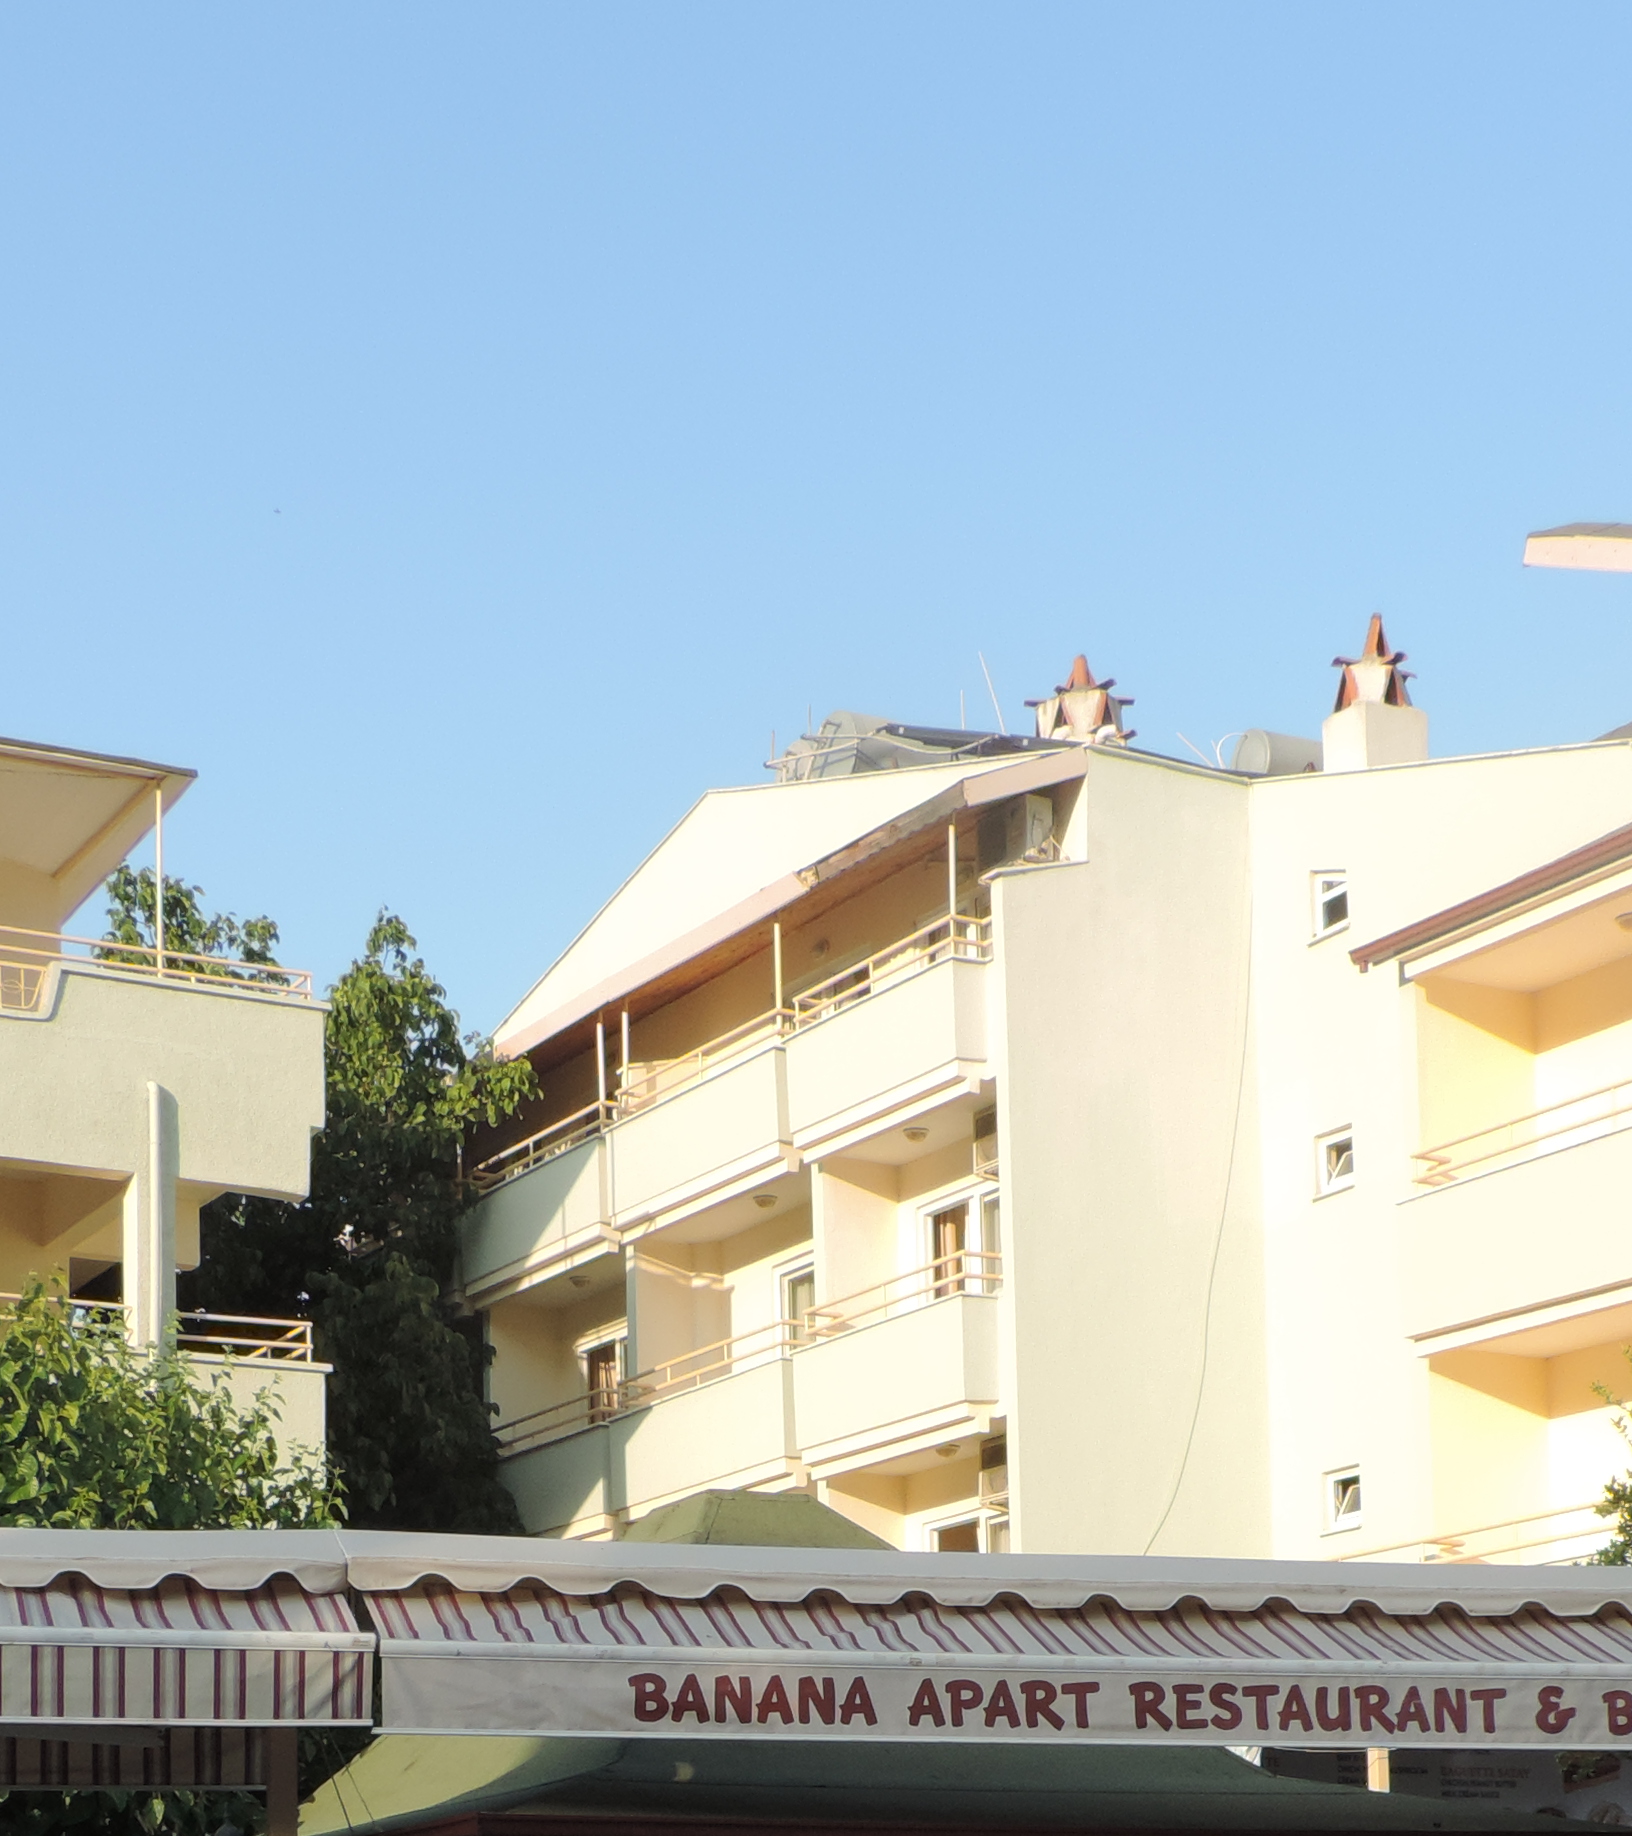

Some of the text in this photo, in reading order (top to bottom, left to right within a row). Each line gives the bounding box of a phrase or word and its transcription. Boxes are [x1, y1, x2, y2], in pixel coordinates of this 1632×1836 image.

[627, 1672, 878, 1726] BANANA
[908, 1677, 1102, 1731] APART
[1129, 1681, 1507, 1735] RESTAURANT
[1535, 1685, 1578, 1736] &
